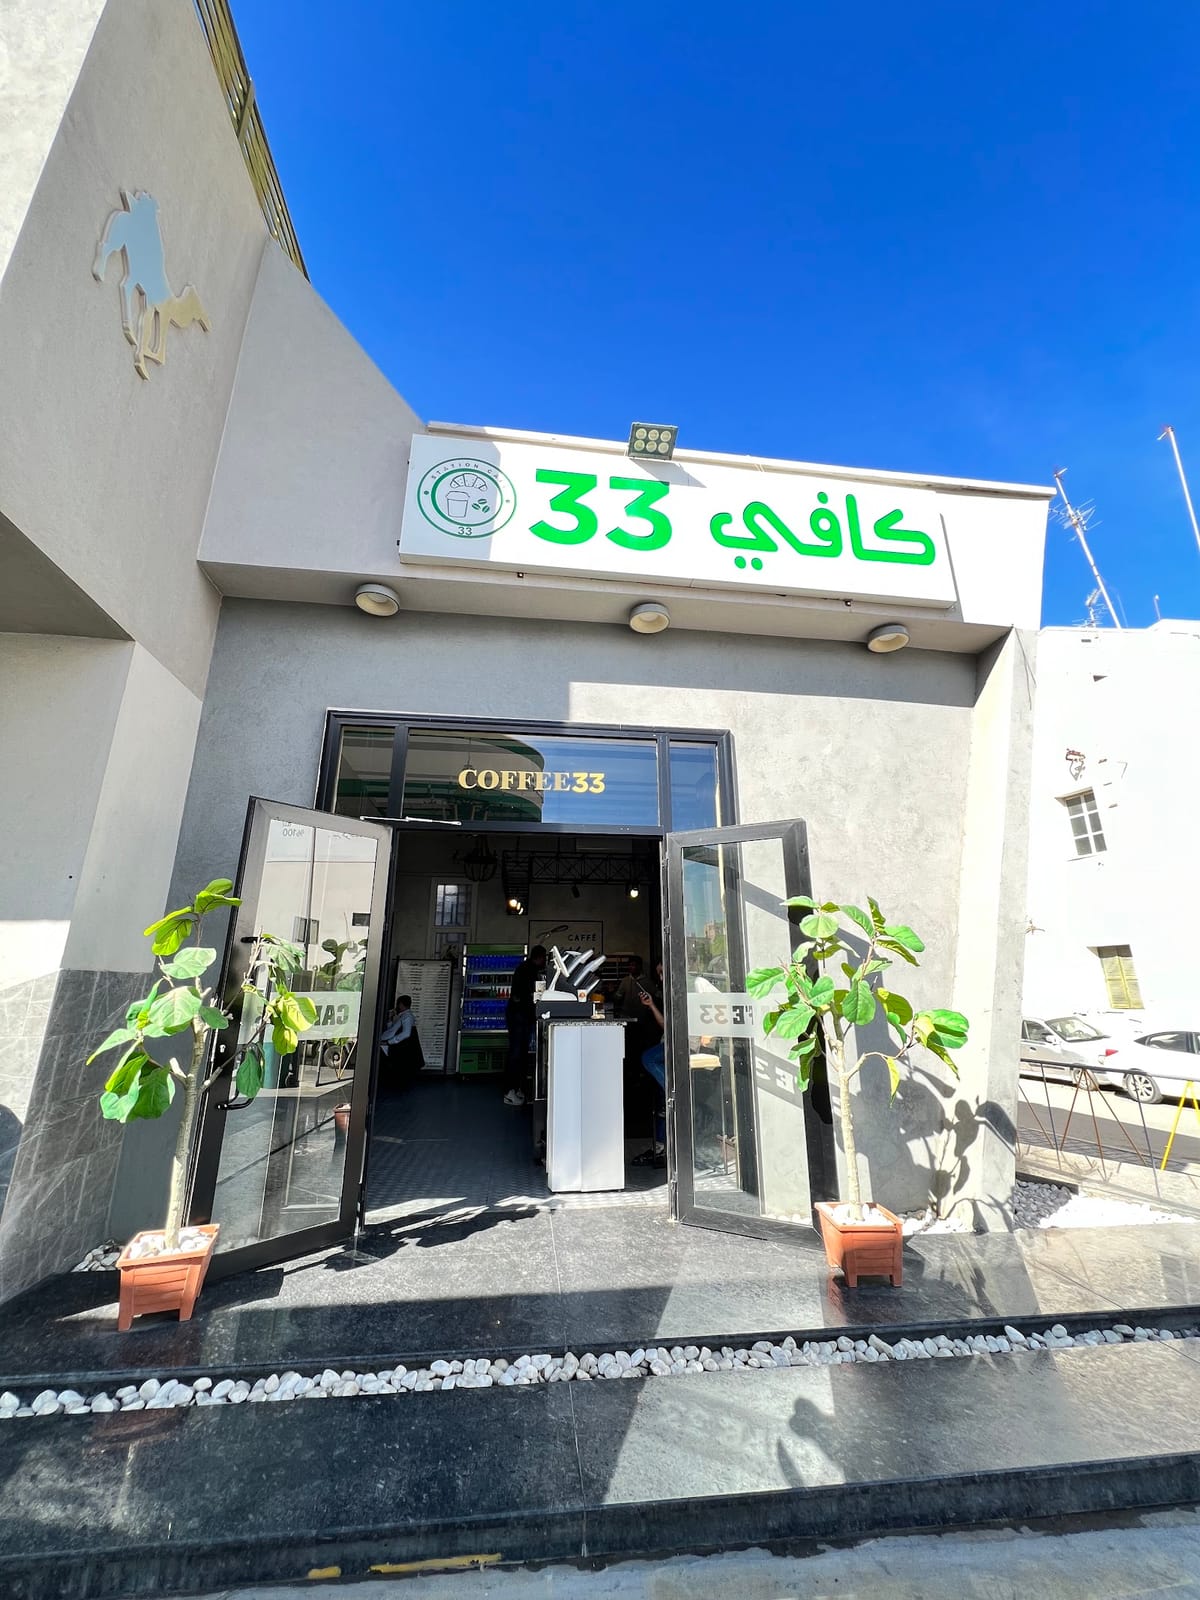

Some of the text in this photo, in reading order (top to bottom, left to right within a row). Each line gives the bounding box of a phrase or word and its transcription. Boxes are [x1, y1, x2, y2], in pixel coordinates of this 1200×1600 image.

[431, 463, 479, 479] STATION
[529, 467, 936, 571] كافي 33
[457, 526, 473, 536] 33
